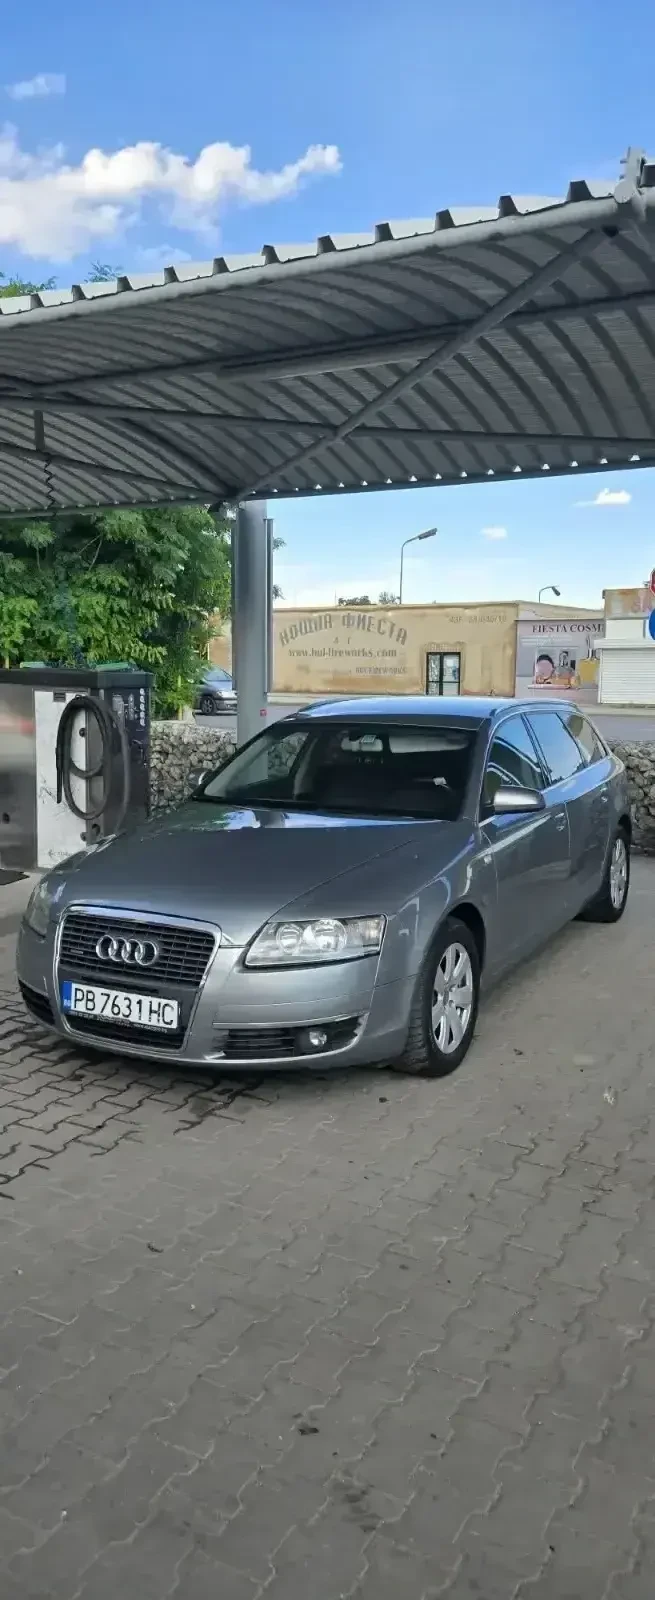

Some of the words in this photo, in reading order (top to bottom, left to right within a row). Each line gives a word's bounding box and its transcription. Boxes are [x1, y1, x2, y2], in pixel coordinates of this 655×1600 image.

[342, 612, 408, 646] ФИЕСТА
[532, 624, 567, 633] FIESTA
[74, 987, 96, 1011] PB
[100, 993, 142, 1021] 7631
[149, 1001, 175, 1025] HC
